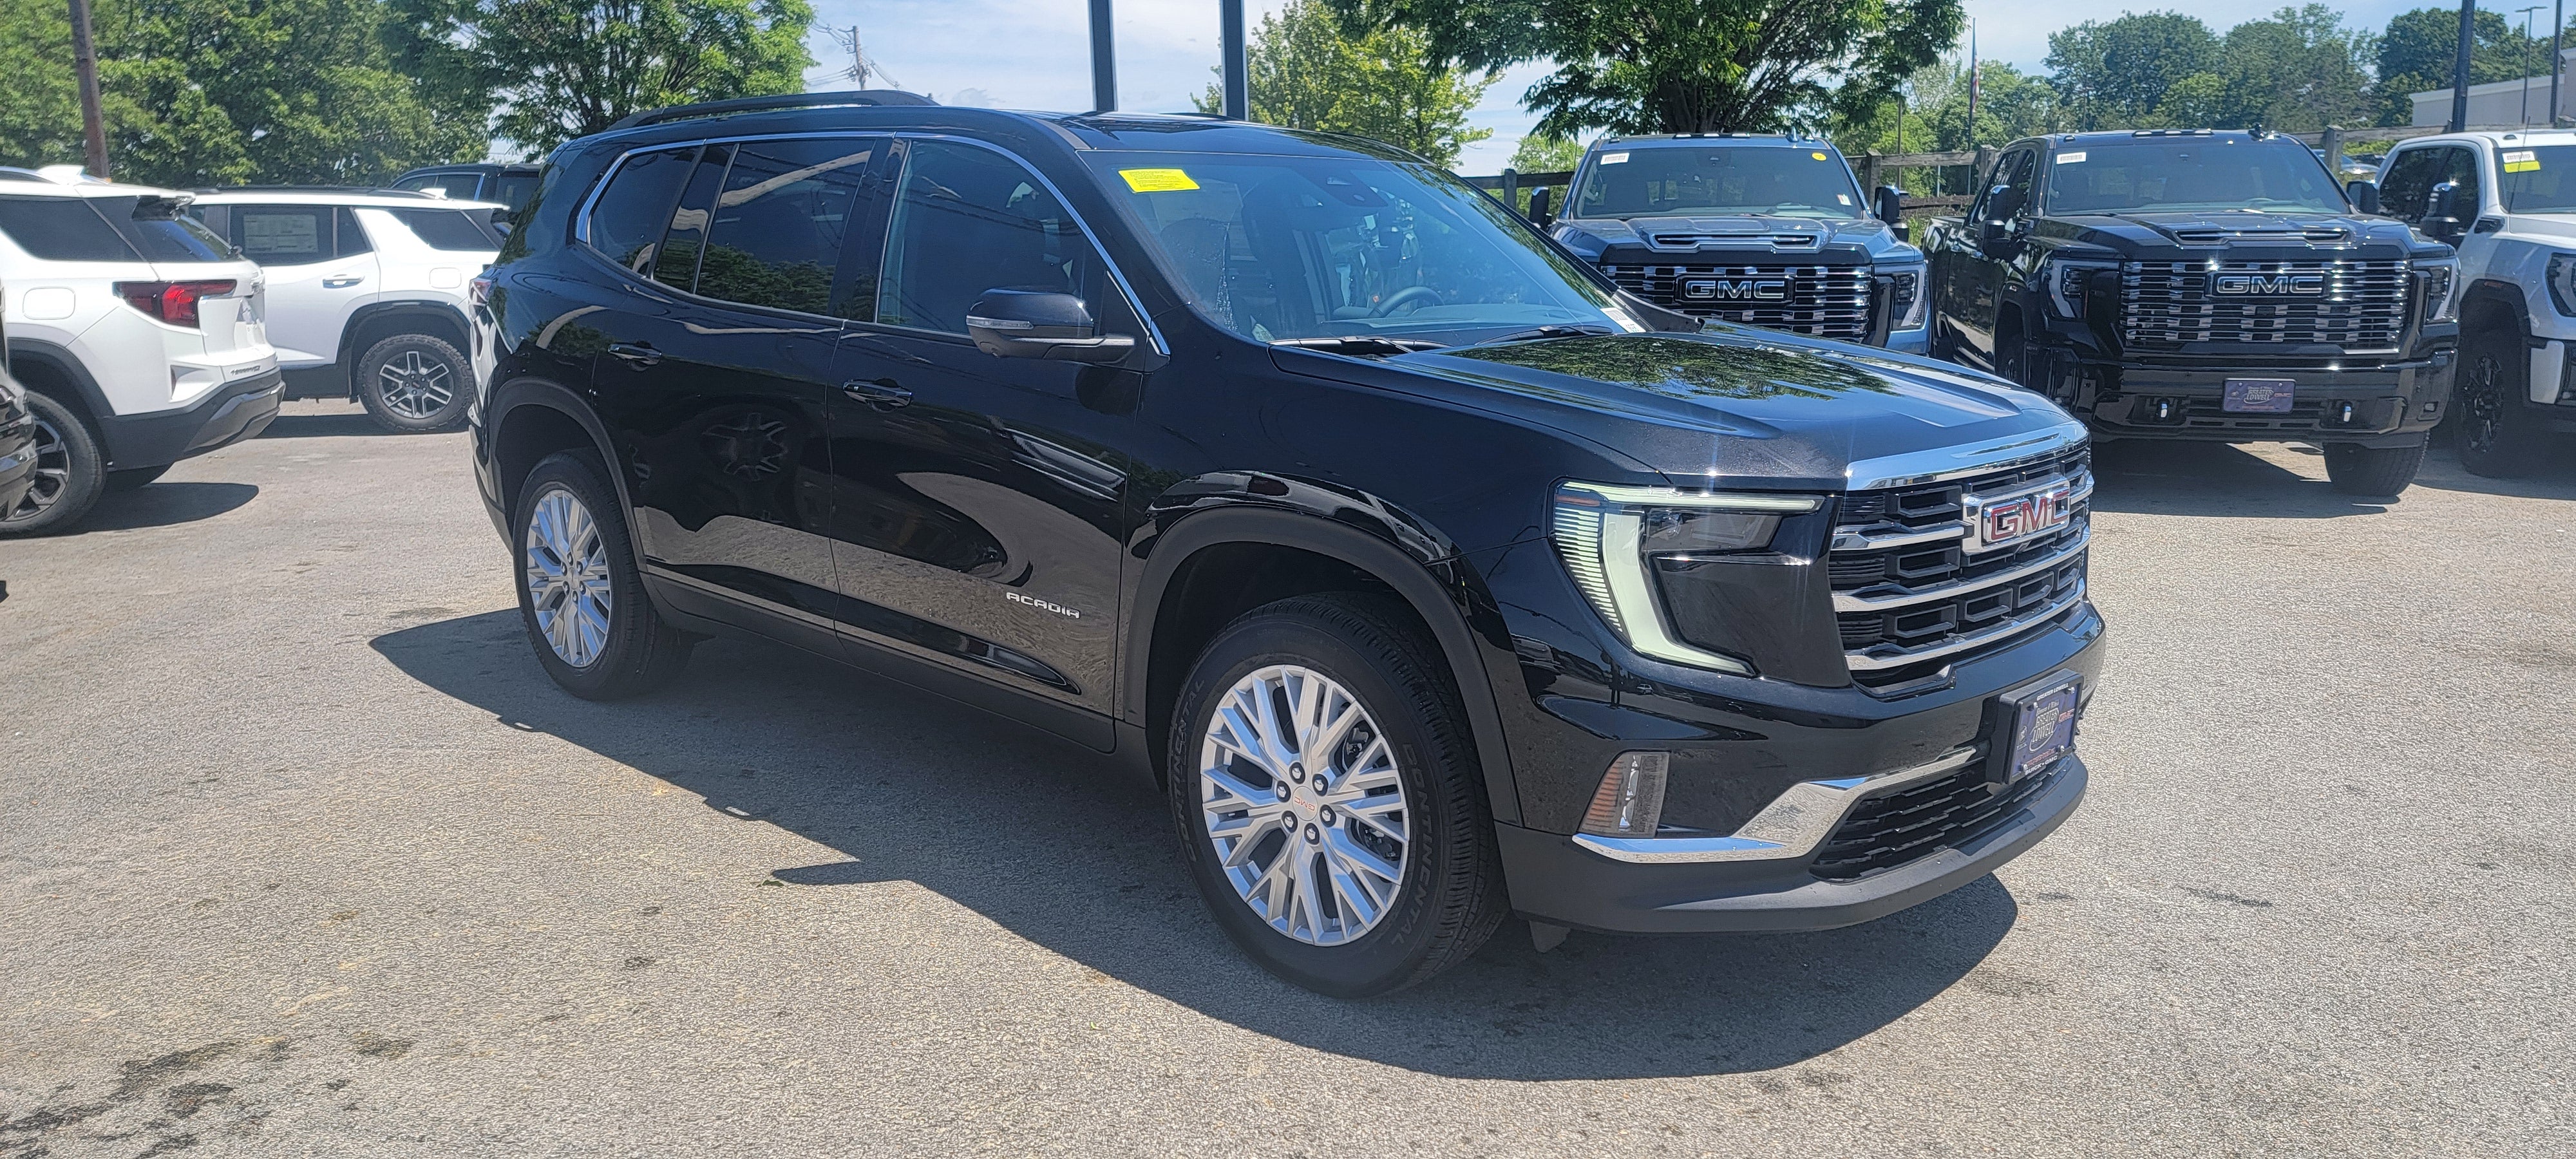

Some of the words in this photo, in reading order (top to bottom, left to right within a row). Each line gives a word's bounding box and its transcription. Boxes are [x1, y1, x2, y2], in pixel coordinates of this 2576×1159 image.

[1685, 281, 1785, 299] GMC
[2217, 276, 2323, 294] GMC
[1988, 487, 2070, 540] GMC
[1006, 592, 1081, 619] ACADIA
[2036, 688, 2054, 701] GREATER
[2053, 683, 2069, 694] LOWELL
[1294, 796, 1315, 811] GMC
[1390, 743, 1433, 946] CONTINENTAL
